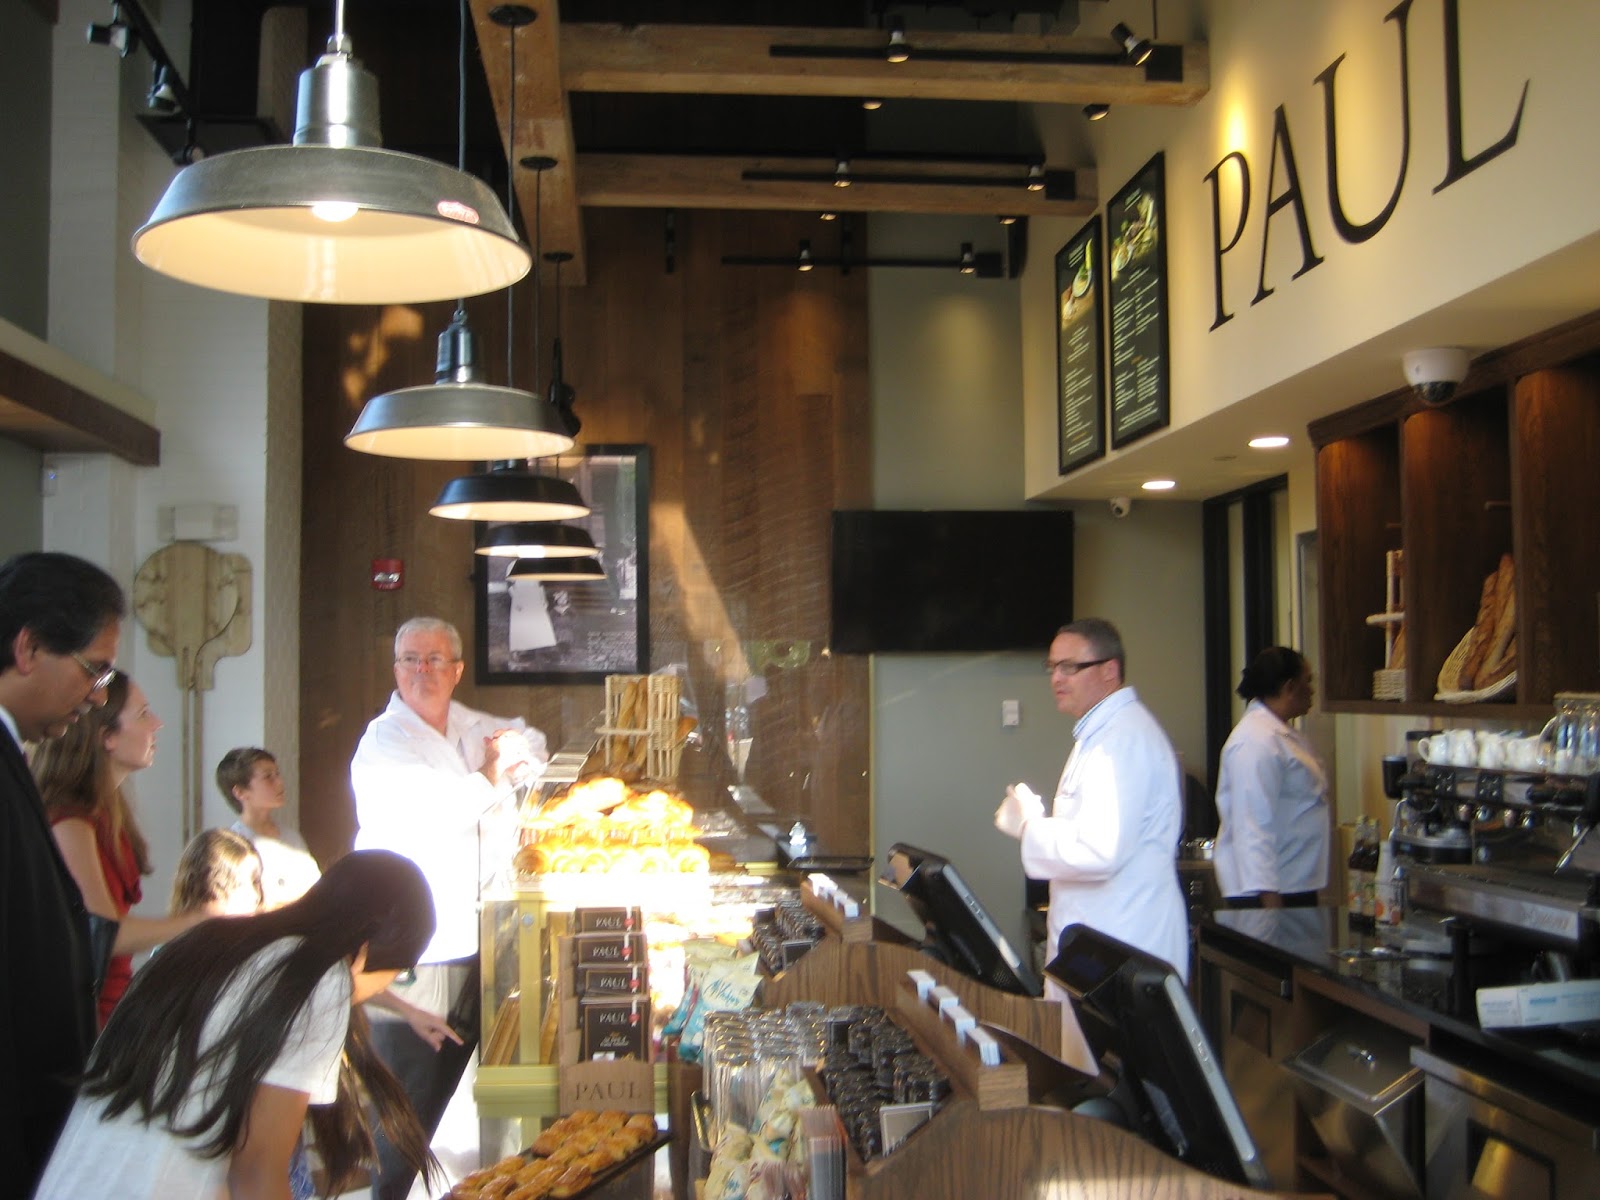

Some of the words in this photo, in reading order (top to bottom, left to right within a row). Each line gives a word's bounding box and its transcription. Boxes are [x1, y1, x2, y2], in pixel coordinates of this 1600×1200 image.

[1203, 0, 1530, 333] PAUL
[595, 916, 622, 929] PAUL
[592, 945, 620, 958] PAUL
[600, 977, 628, 990] PAUL
[599, 1012, 628, 1025] PAUL
[574, 1082, 641, 1100] PAUL
